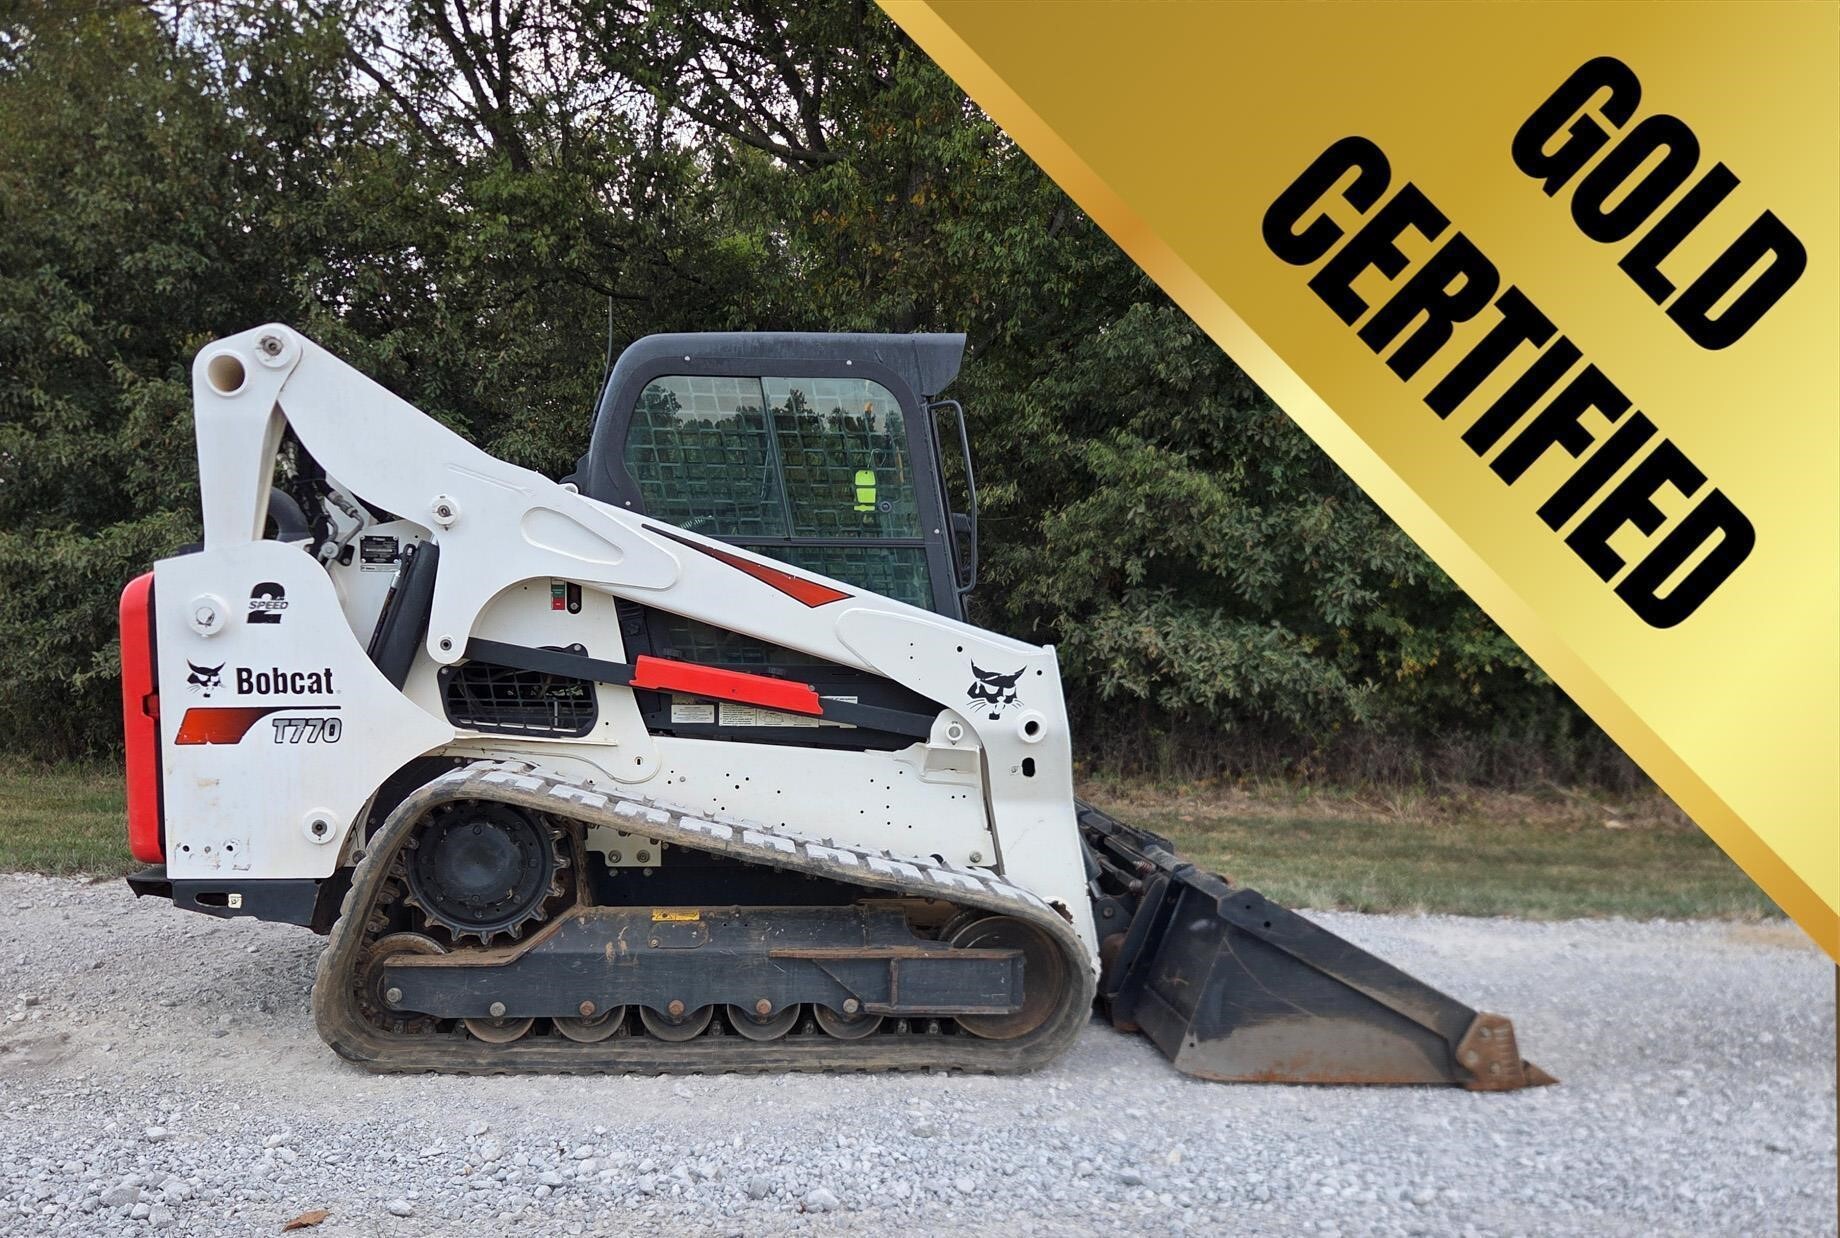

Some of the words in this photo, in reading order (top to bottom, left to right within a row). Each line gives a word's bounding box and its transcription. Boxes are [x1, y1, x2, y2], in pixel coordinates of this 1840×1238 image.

[247, 582, 286, 624] 2
[248, 600, 289, 610] SPEED
[236, 667, 334, 695] Bobcat
[272, 717, 343, 744] T770
